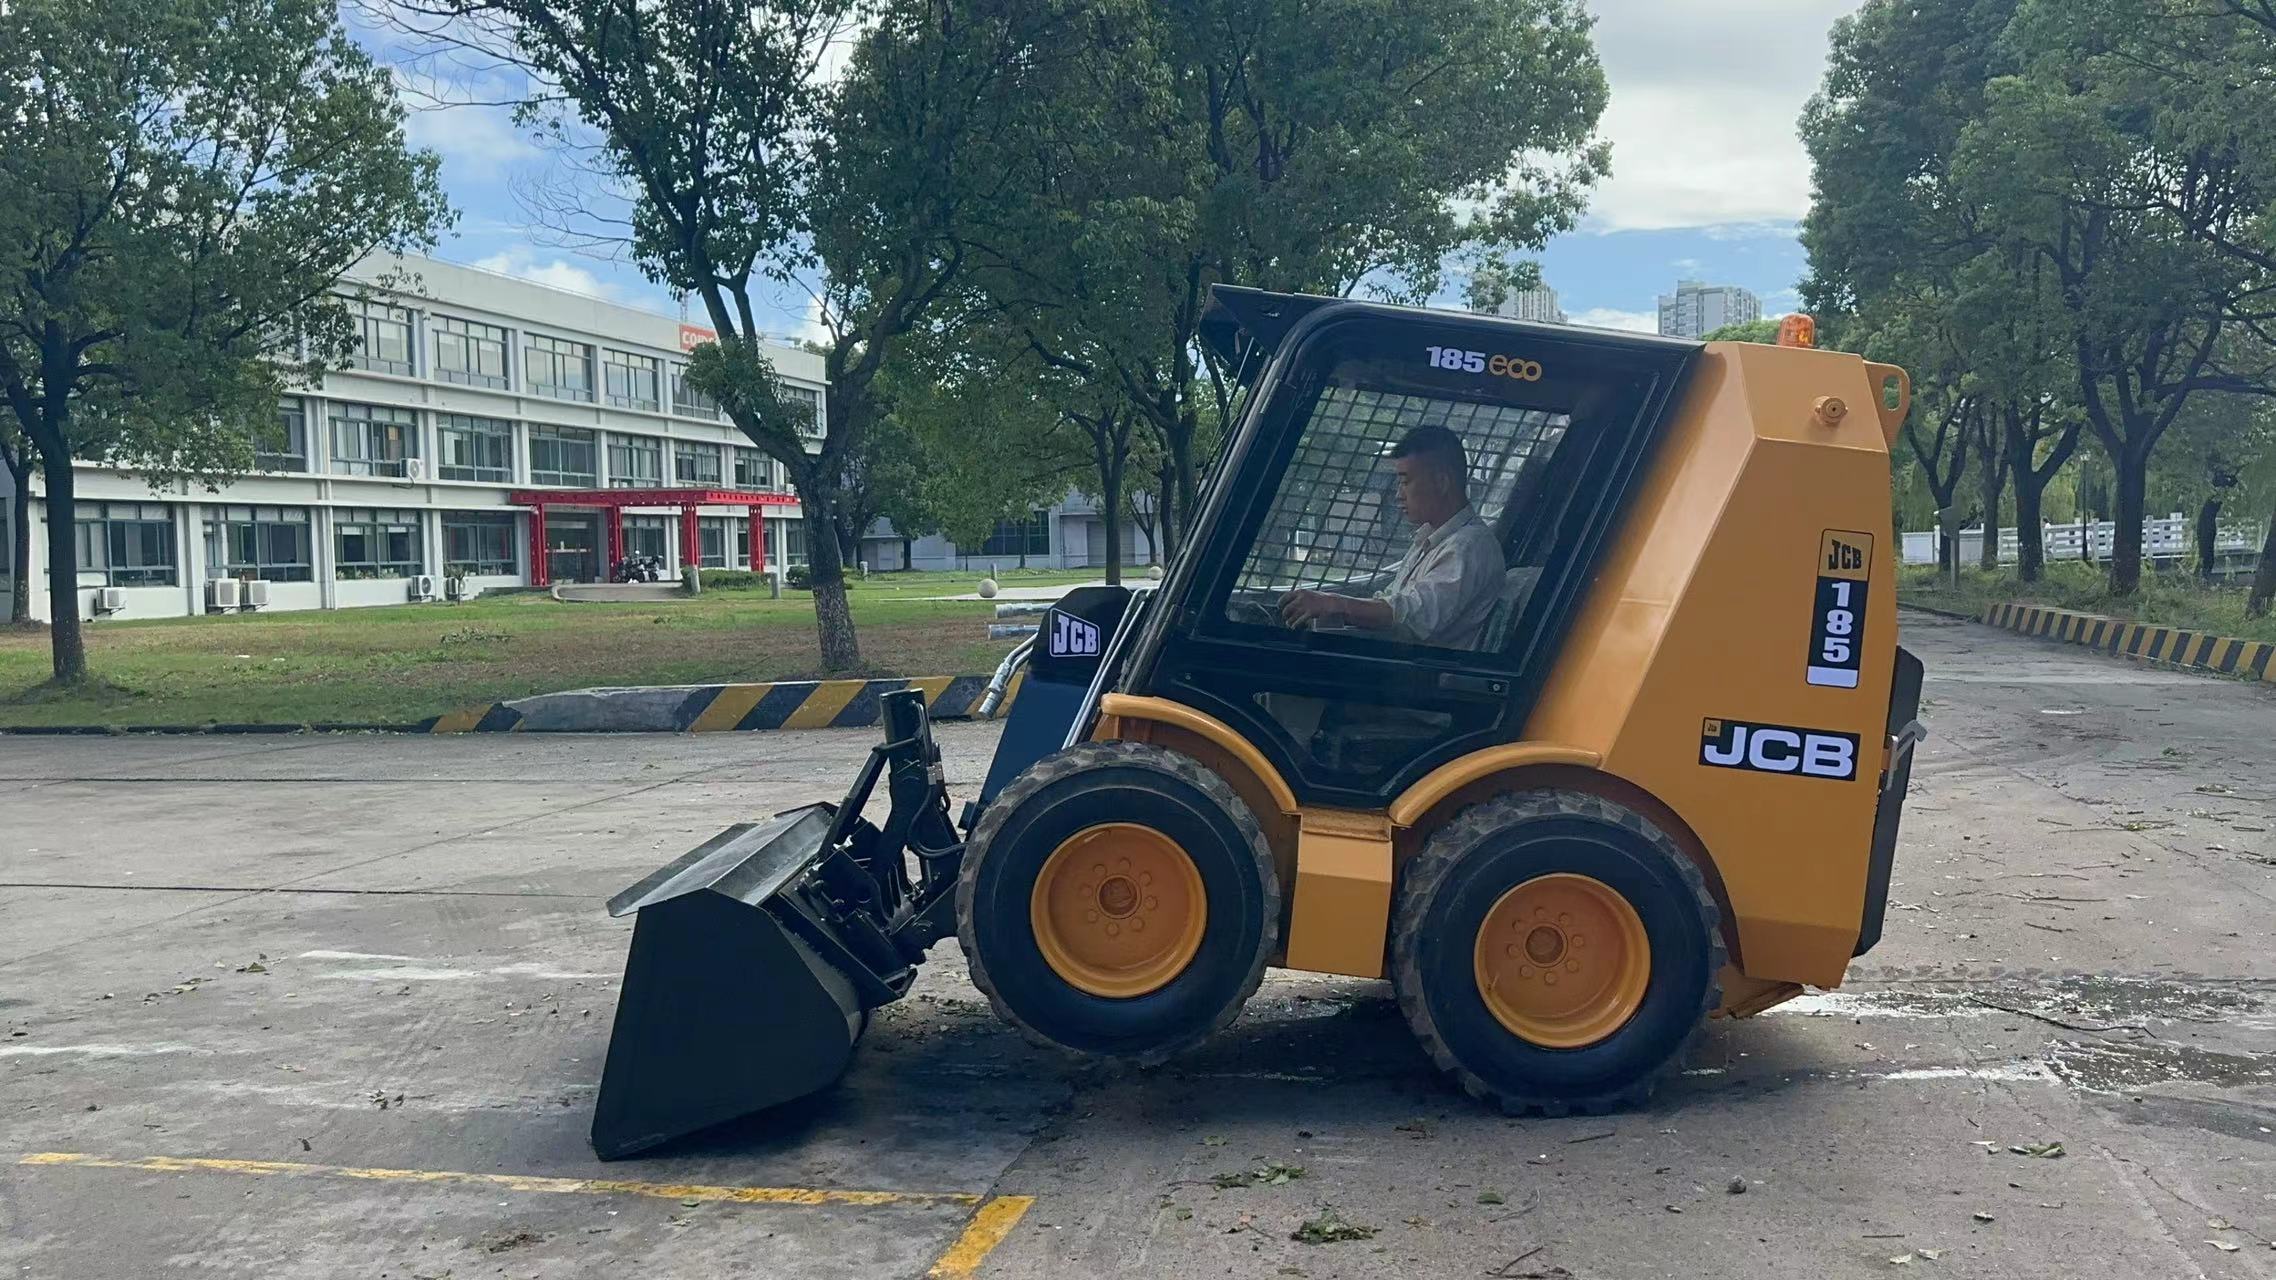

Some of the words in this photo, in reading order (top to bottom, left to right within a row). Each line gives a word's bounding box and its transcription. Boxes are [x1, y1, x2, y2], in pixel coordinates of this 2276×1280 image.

[1828, 538, 1862, 570] JCB
[1053, 613, 1097, 653] JCB
[1704, 726, 1854, 777] JCB
